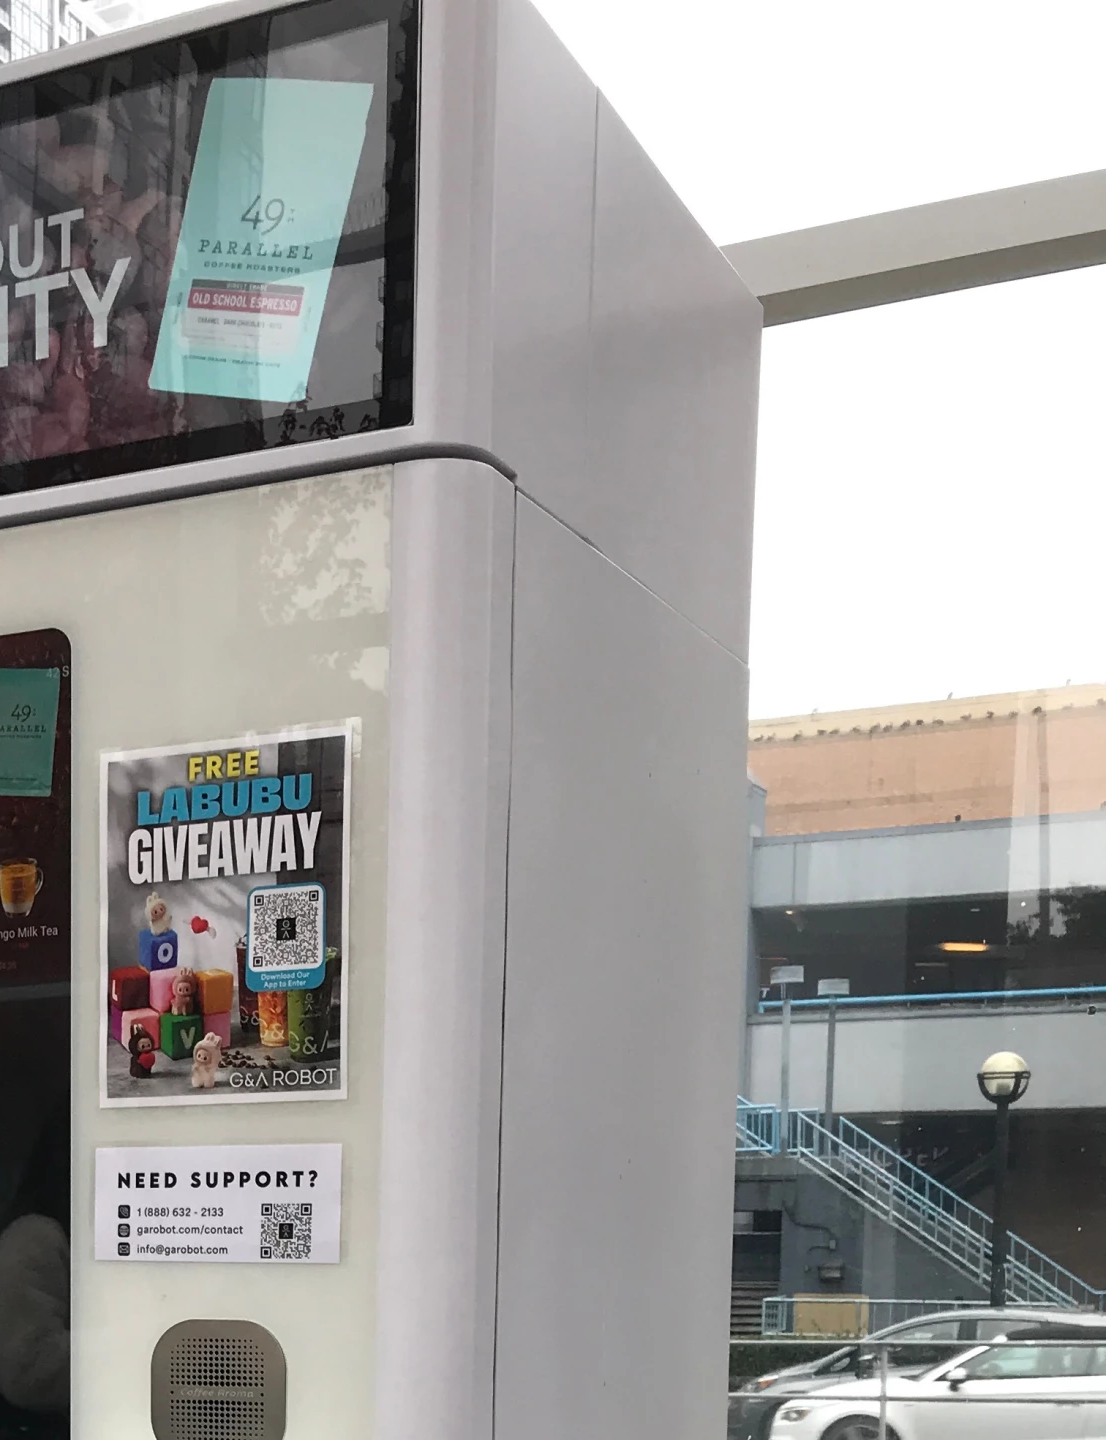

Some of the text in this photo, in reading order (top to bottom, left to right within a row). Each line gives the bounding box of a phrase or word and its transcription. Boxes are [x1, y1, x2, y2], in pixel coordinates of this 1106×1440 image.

[198, 239, 314, 260] PARALLEL
[246, 263, 301, 274] ROASTERS
[192, 293, 298, 312] OLD SCHOOL ESPRESSO
[46, 667, 60, 678] 42
[188, 750, 260, 782] FREE
[137, 773, 313, 826] LABUBU
[128, 810, 323, 885] GIVEAWAY
[17, 926, 38, 938] Milk
[40, 925, 59, 936] Tea
[261, 971, 295, 981] Download
[264, 981, 278, 989] App
[273, 1068, 337, 1086] ROBOT
[118, 1170, 318, 1188] NEED SUPPORT?
[144, 1207, 170, 1218] (888)
[172, 1207, 191, 1217] 632
[201, 1207, 224, 1217] 2133
[137, 1224, 243, 1236] garobot.com/contact
[137, 1244, 228, 1256] info@garobot.com
[180, 1388, 254, 1398] Coffee Aroma
